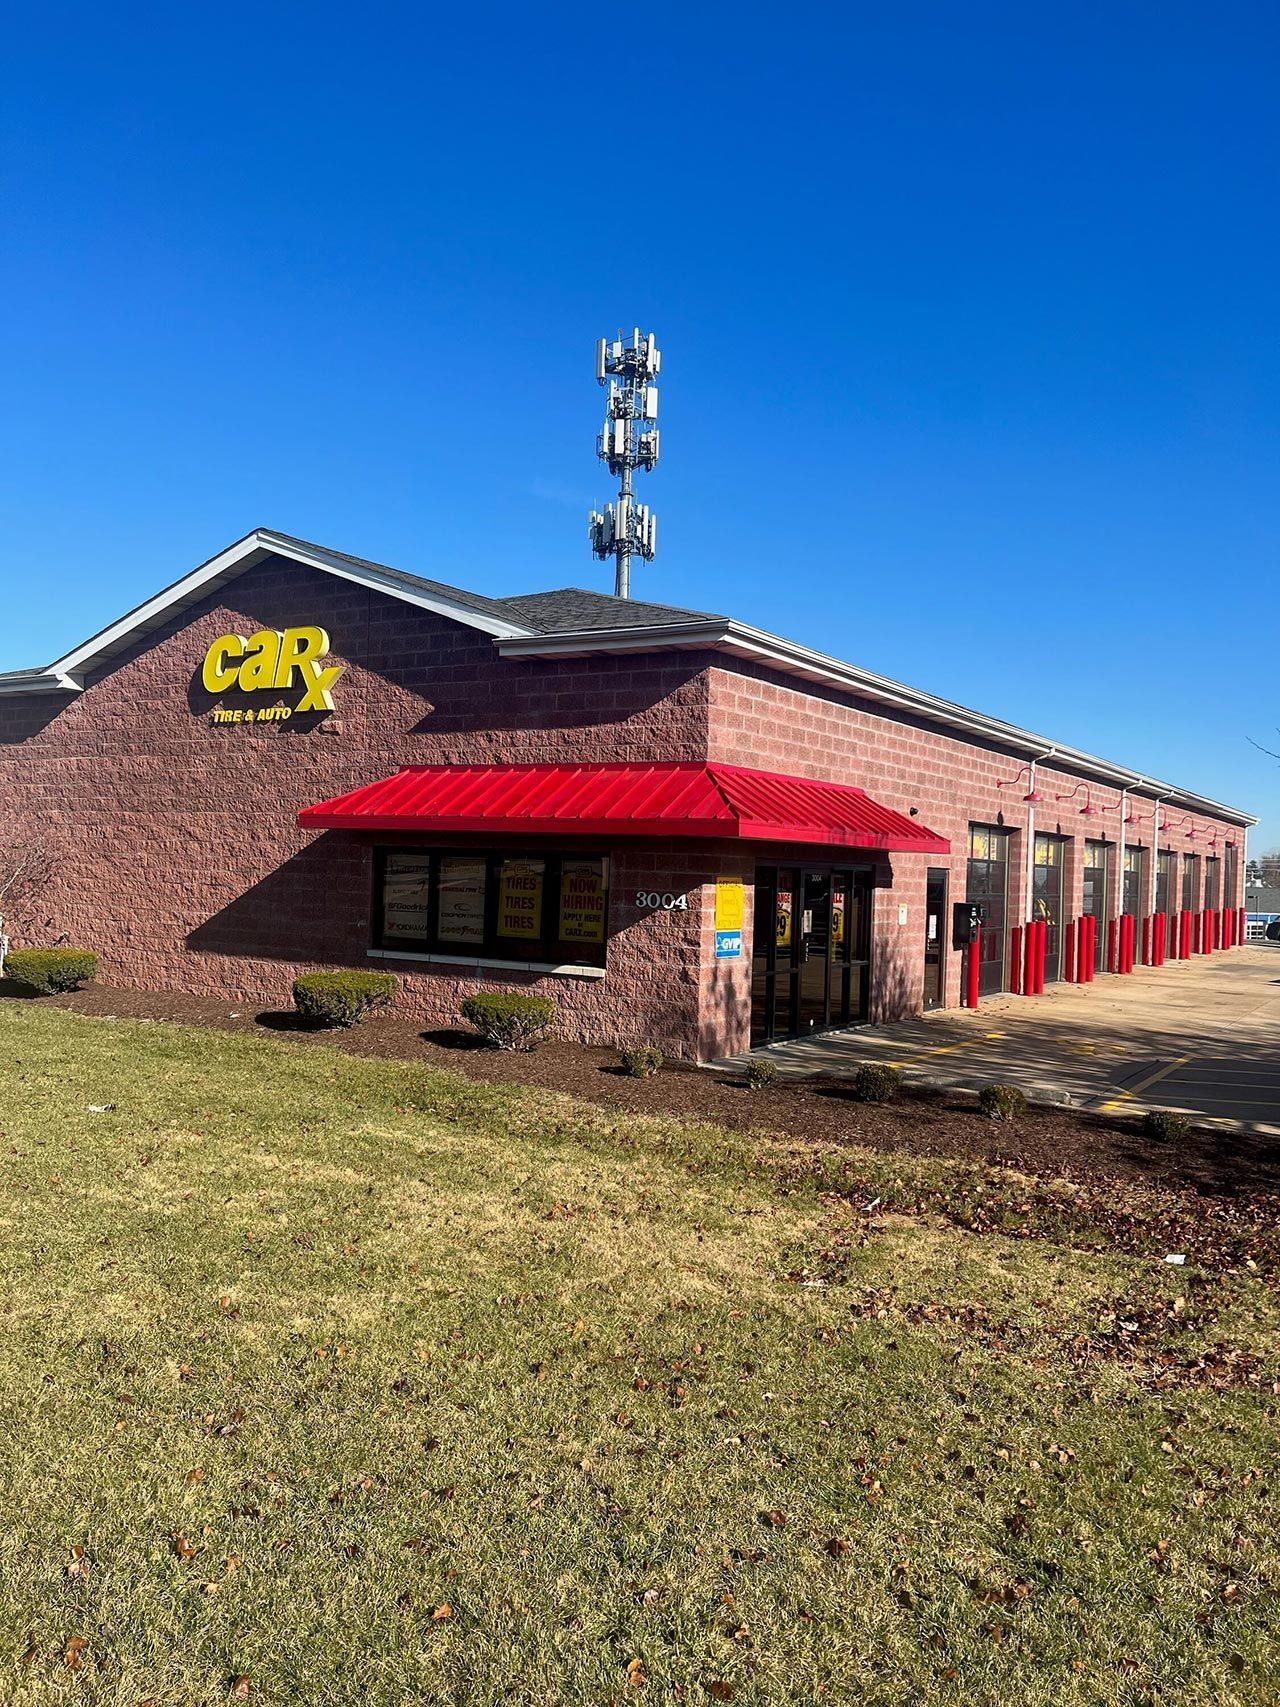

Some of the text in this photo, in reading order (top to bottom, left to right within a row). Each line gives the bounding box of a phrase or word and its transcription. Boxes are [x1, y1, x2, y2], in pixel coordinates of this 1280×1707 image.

[213, 706, 292, 723] TIRE & AUTO
[506, 877, 537, 891] TIRES
[569, 878, 598, 893] NOW
[504, 896, 536, 910] TIRES
[562, 895, 603, 911] HIRING
[635, 891, 688, 910] 3004
[503, 915, 534, 929] TIRES
[563, 912, 602, 923] APPLY HERE
